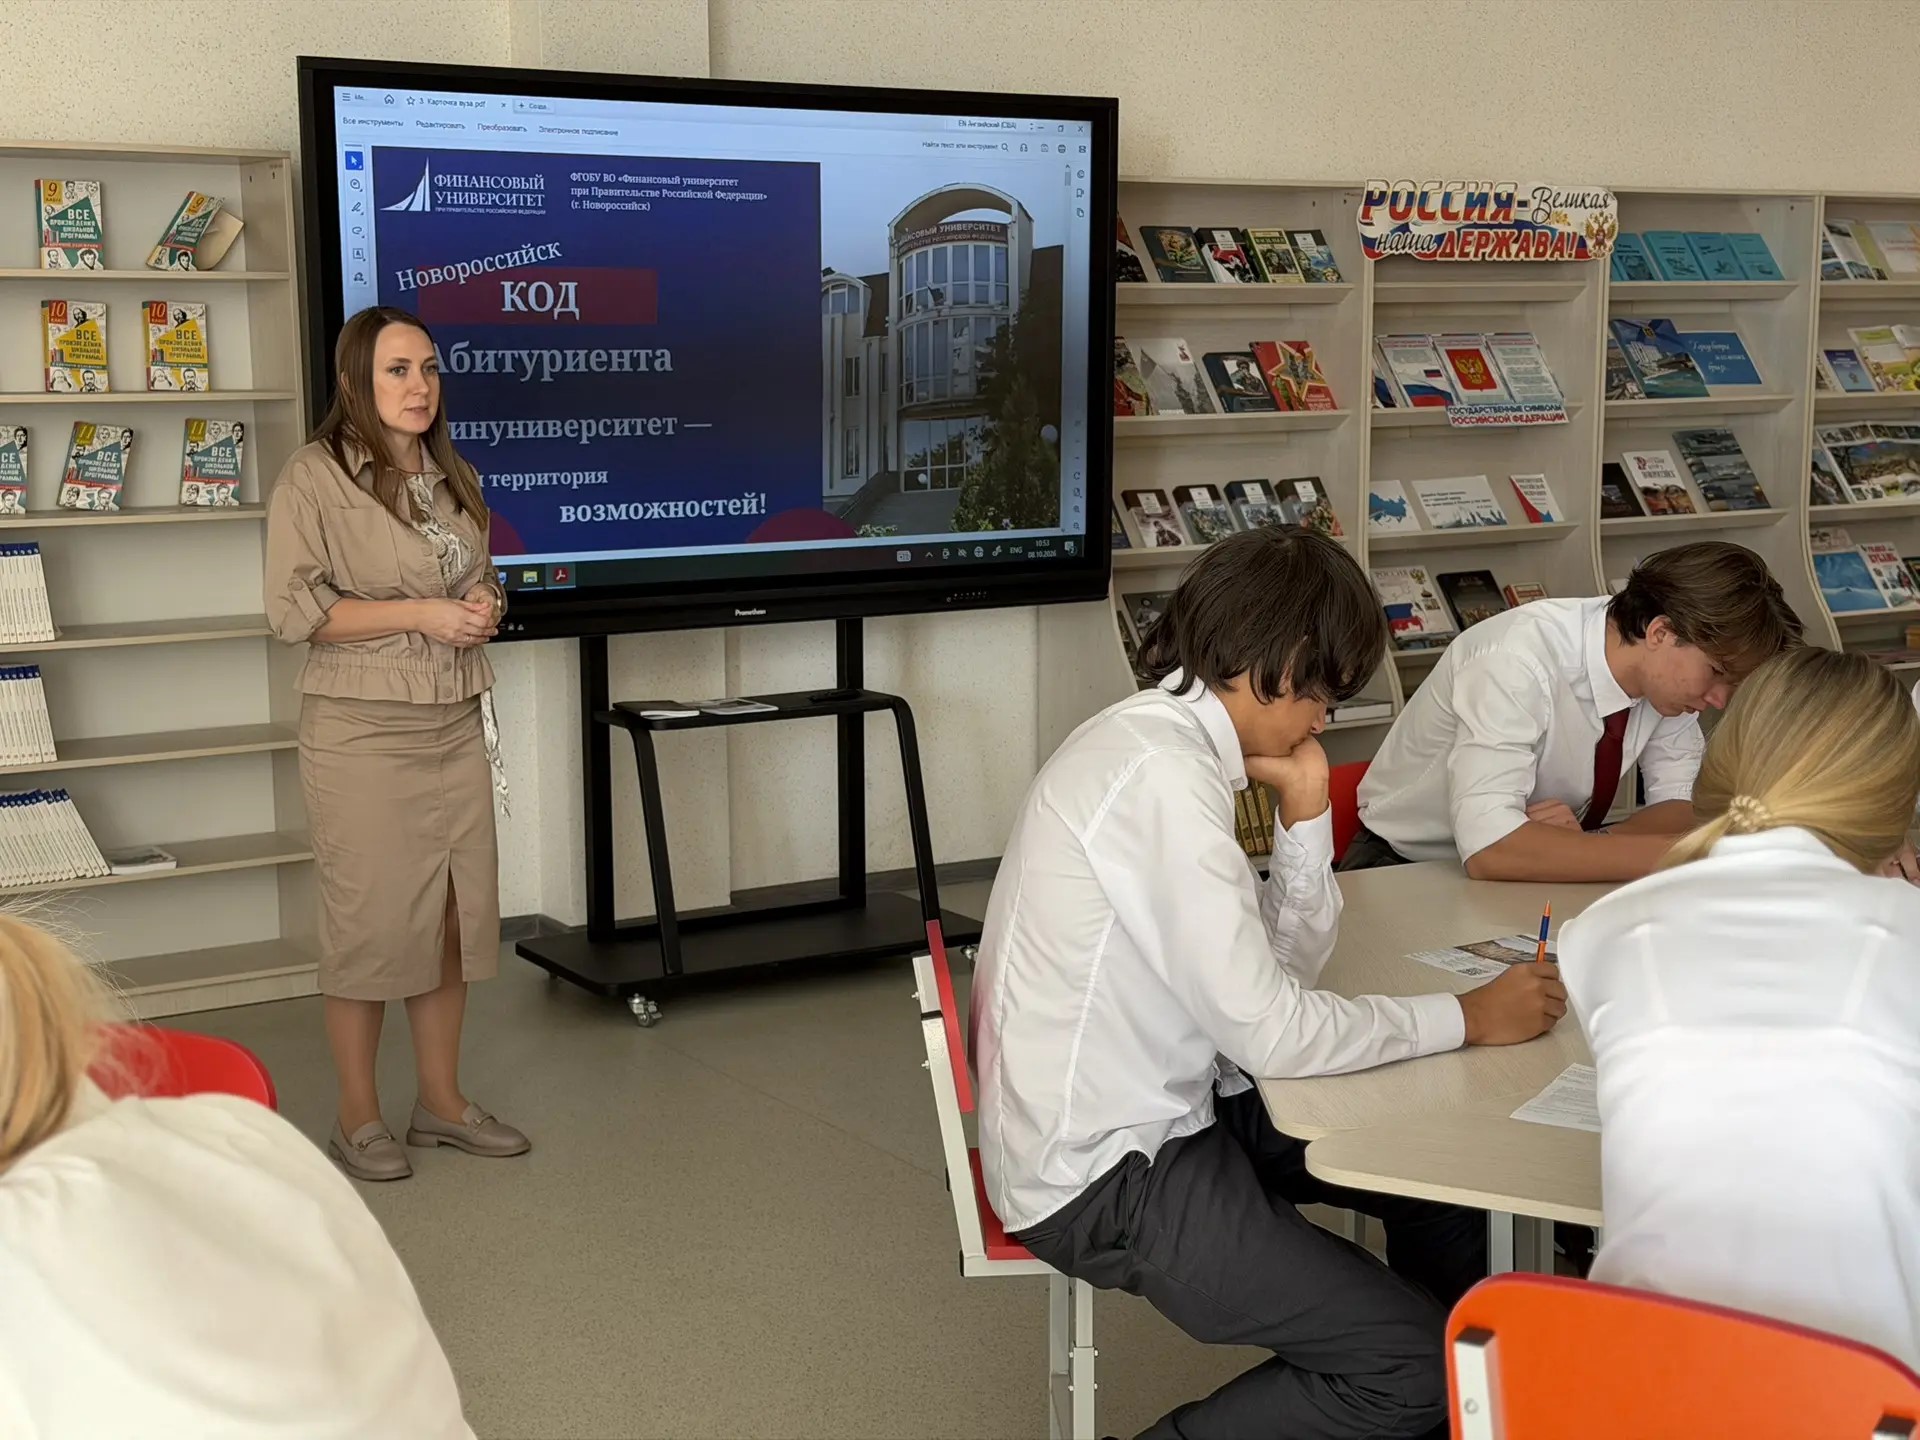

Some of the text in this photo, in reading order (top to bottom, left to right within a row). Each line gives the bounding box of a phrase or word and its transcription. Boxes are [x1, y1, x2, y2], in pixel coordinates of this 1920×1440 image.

[427, 98, 458, 108] Карточка
[342, 116, 404, 129] Все инструменты
[416, 120, 466, 130] Редактировать
[477, 123, 527, 133] Преобразовать
[434, 174, 545, 190] ФИНАНСОВЫЙ
[570, 172, 739, 188] ФГОБУ ВО «Финансовый университет
[48, 182, 57, 196] 9
[571, 187, 768, 201] при Правительстве Российской Федерации»
[435, 191, 545, 207] УНИВЕРСИТЕТ
[1531, 186, 1611, 225] Великая
[571, 200, 651, 212] (г. Новороссийск)
[67, 209, 90, 220] ВСЕ
[939, 222, 1001, 233] УНИВЕРСИТЕТ
[1375, 232, 1578, 259] наша ДЕРЖАВА!
[395, 241, 562, 291] Новороссийск
[501, 281, 580, 320] КОД
[51, 302, 66, 317] 10
[151, 303, 166, 318] 10
[76, 330, 97, 341] ВСЕ
[176, 330, 197, 341] ВСЕ
[1449, 403, 1562, 415] ГОСУДАРСТВЕННЫЕ СИМВОЛЫ
[1451, 412, 1566, 425] РОССИЙСКОЙ ФЕДЕРАЦИИ
[80, 425, 95, 438] 11
[191, 421, 205, 435] 11
[447, 416, 678, 446] инуниверситет
[1, 452, 16, 463] СЕ
[96, 451, 119, 463] ВСЕ
[211, 447, 233, 458] ВСЕ
[489, 470, 608, 491] территория
[559, 492, 767, 523] возможностей!
[1009, 546, 1023, 554] ENG
